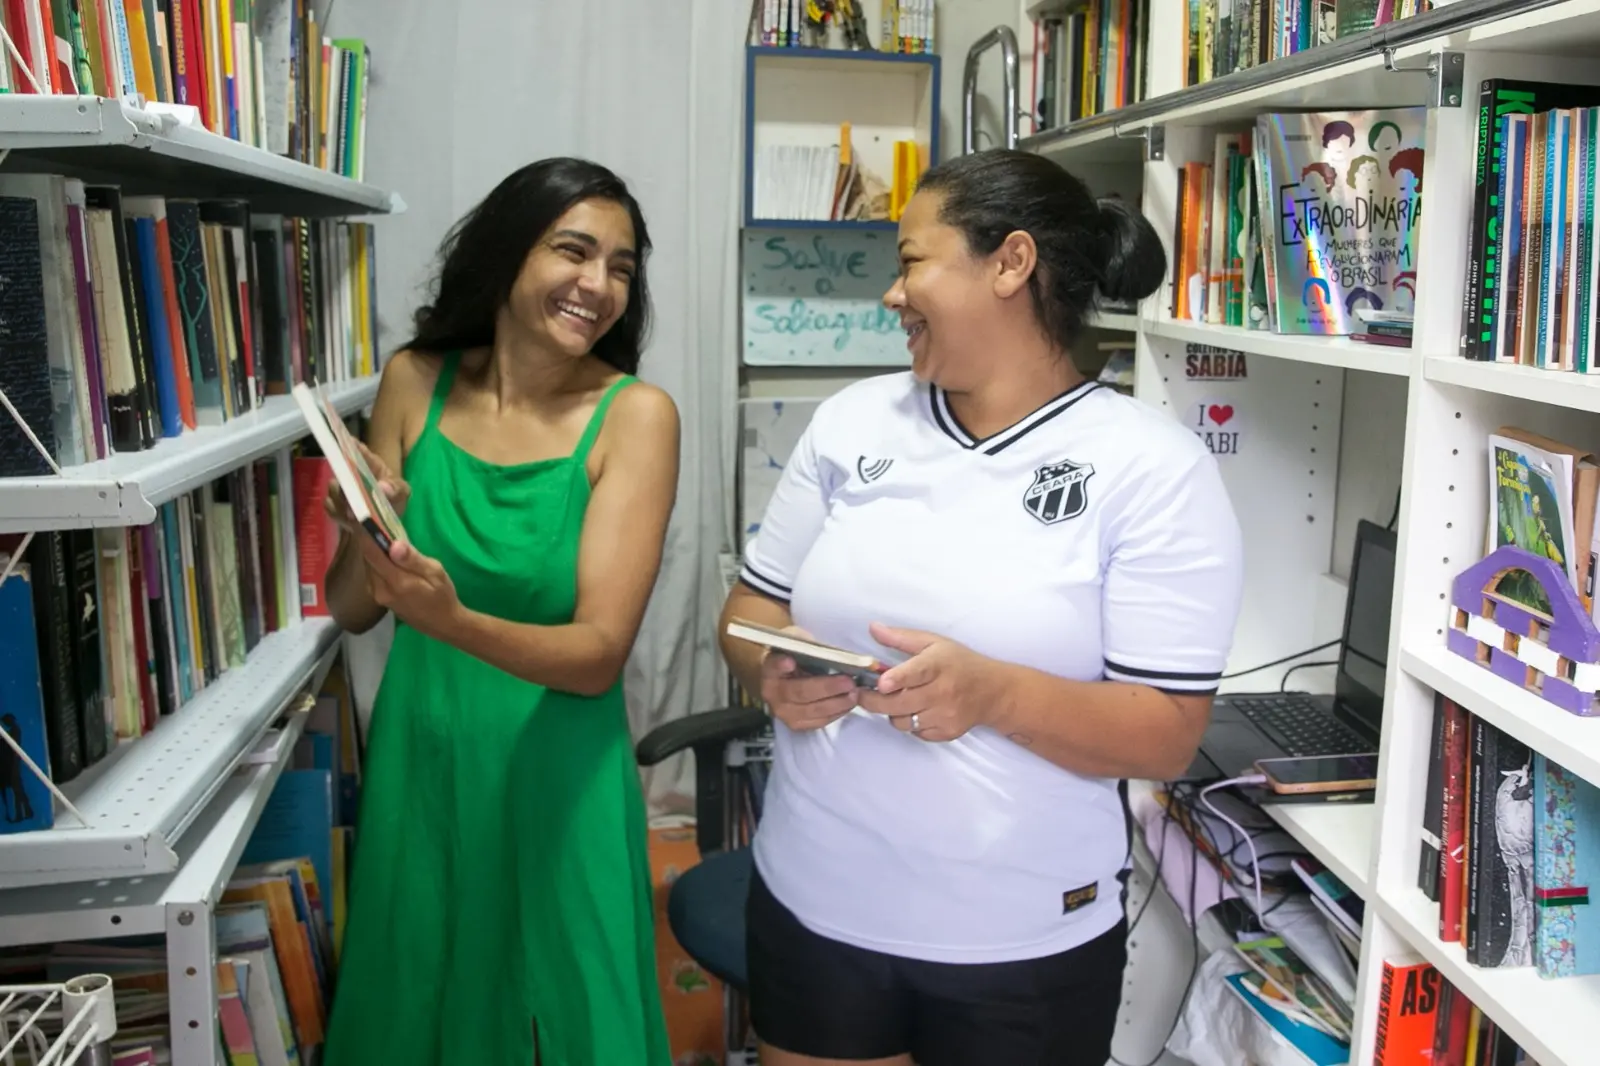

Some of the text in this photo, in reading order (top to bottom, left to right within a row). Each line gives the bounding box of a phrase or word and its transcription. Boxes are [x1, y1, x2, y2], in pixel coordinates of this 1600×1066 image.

[1477, 106, 1488, 186] KRIPTONITA
[1586, 137, 1595, 221] PAULO COELHO
[1307, 244, 1411, 271] REVOLUCIONARAM
[1325, 237, 1396, 254] MULHERES QUE
[1331, 266, 1387, 288] O BRASIL
[1469, 288, 1477, 324] BEVERE
[1198, 404, 1206, 427] I
[1195, 432, 1239, 455] ABI
[1380, 966, 1393, 1005] HOJE
[1400, 967, 1436, 1016] AS
